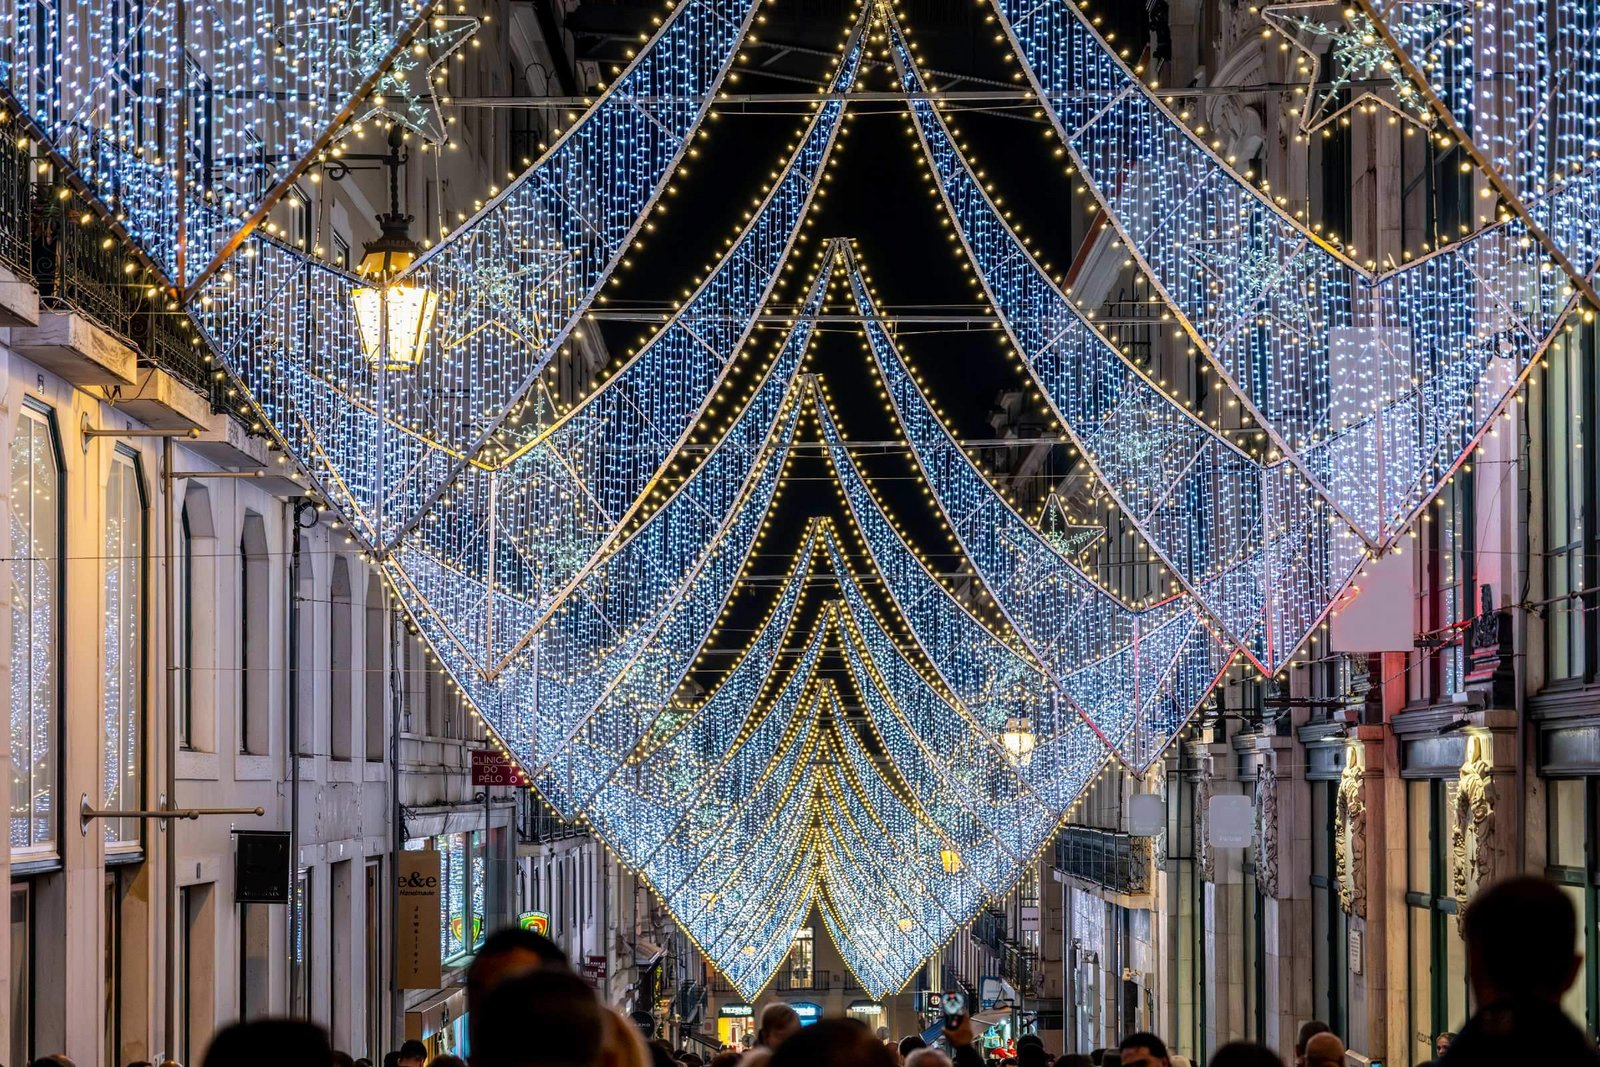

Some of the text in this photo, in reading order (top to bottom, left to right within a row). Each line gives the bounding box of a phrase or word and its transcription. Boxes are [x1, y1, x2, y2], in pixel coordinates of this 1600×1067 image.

[472, 755, 510, 764] CLÍNICA
[479, 774, 503, 783] PÊLO
[398, 872, 437, 888] e&e
